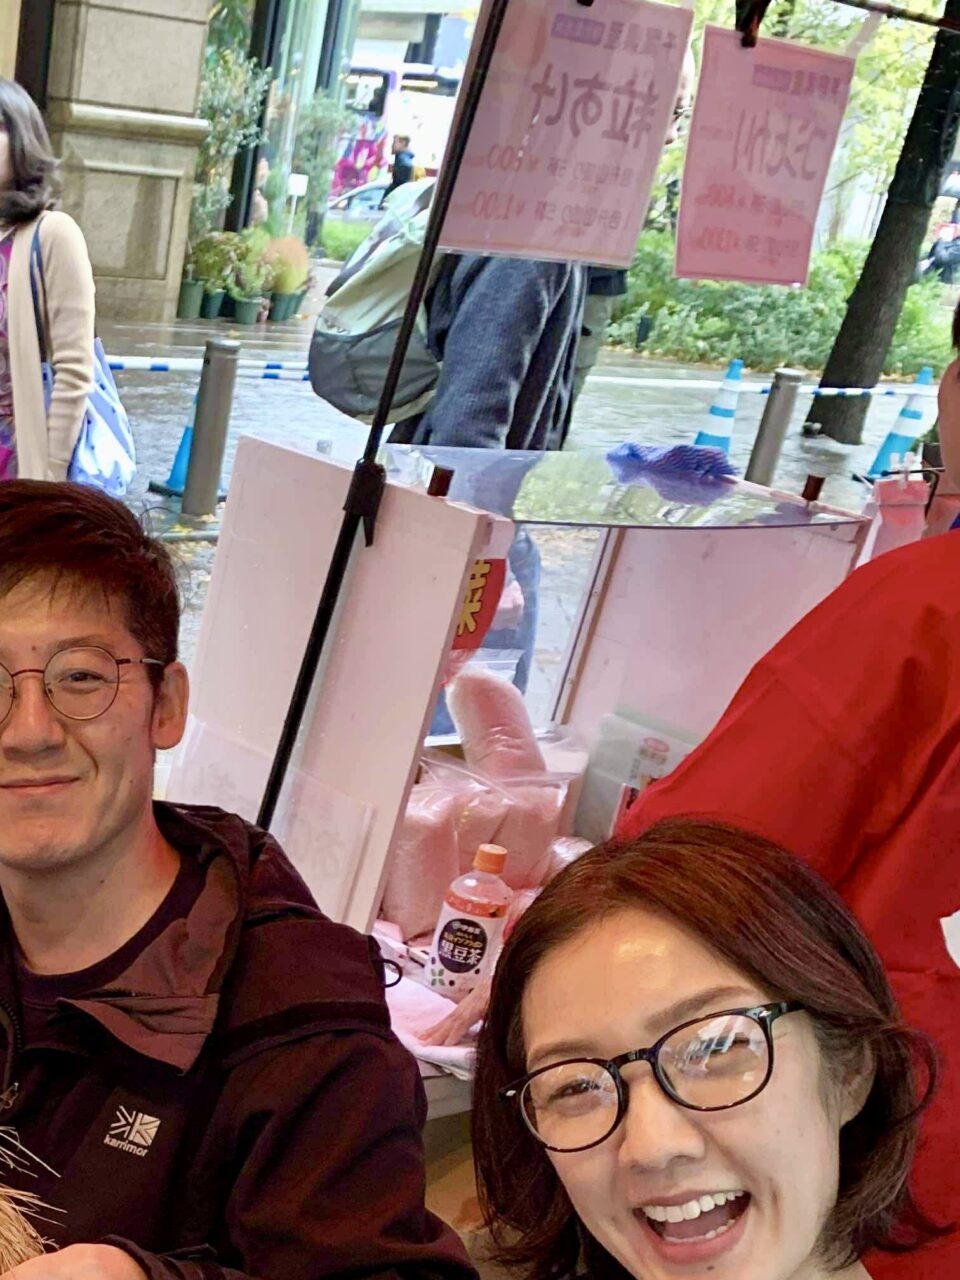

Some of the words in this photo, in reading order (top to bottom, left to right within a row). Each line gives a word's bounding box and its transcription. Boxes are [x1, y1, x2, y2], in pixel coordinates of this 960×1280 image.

[439, 941, 482, 965] 黒豆茶
[103, 1134, 149, 1157] karrimor
